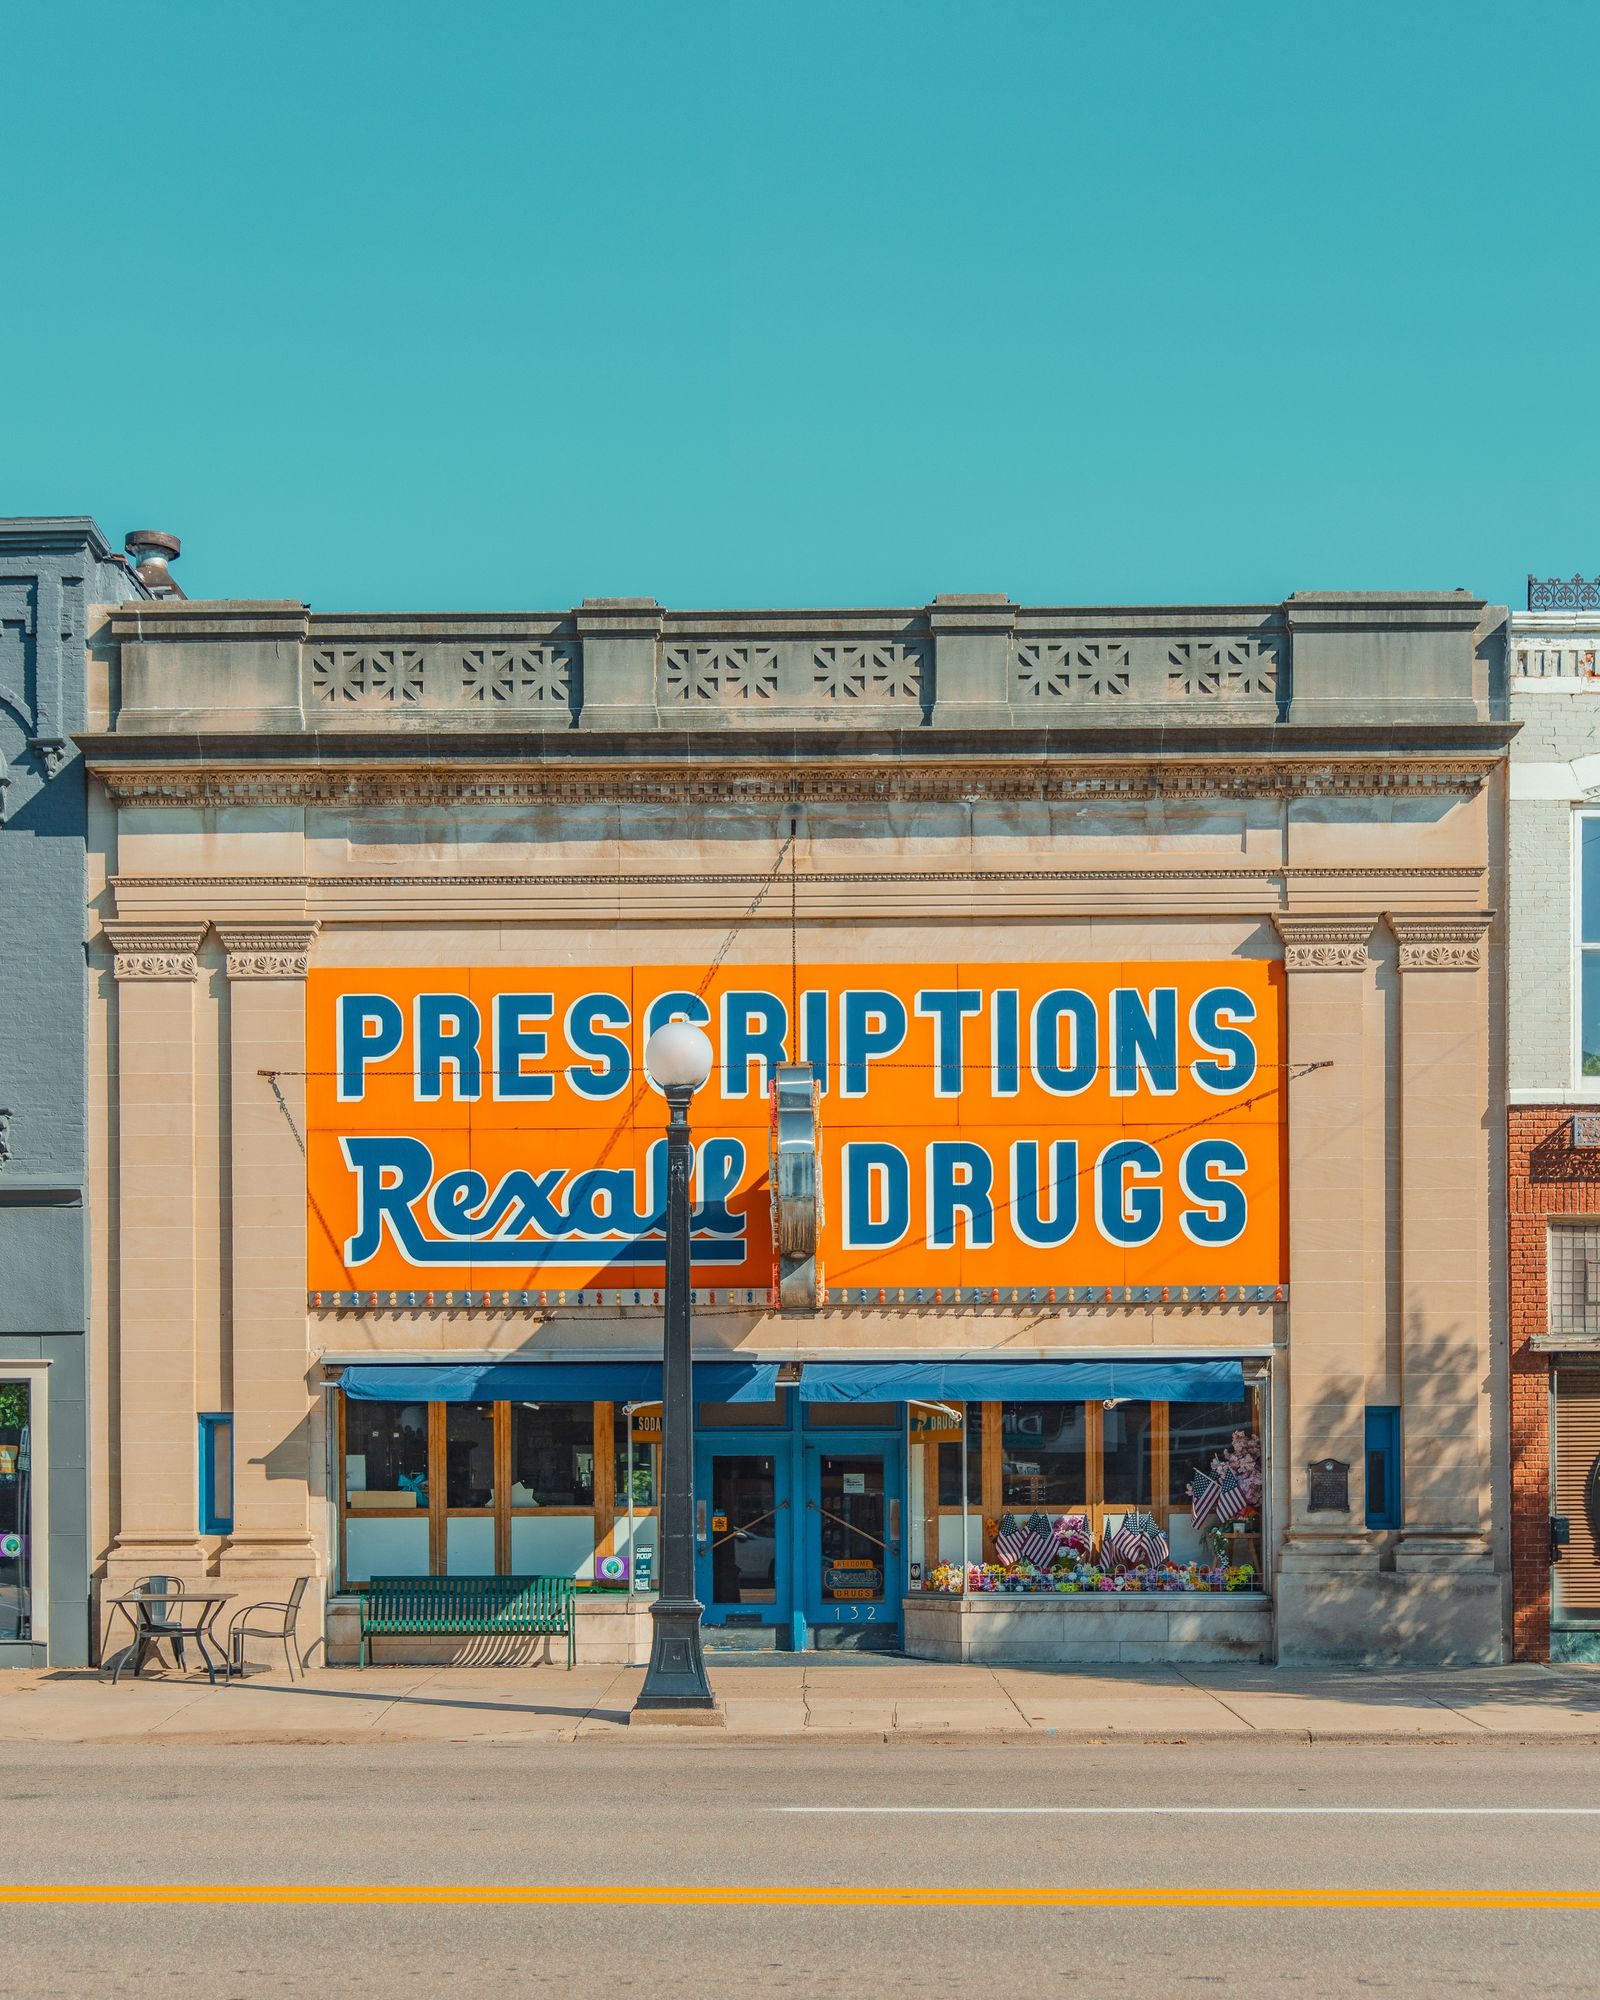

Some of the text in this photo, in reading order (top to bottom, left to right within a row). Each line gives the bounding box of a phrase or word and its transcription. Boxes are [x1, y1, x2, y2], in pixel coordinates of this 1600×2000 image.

[841, 1139, 1249, 1251] DRUGS
[638, 1416, 661, 1431] SODA
[836, 1590, 872, 1598] DRUGS
[834, 1606, 876, 1621] 132
